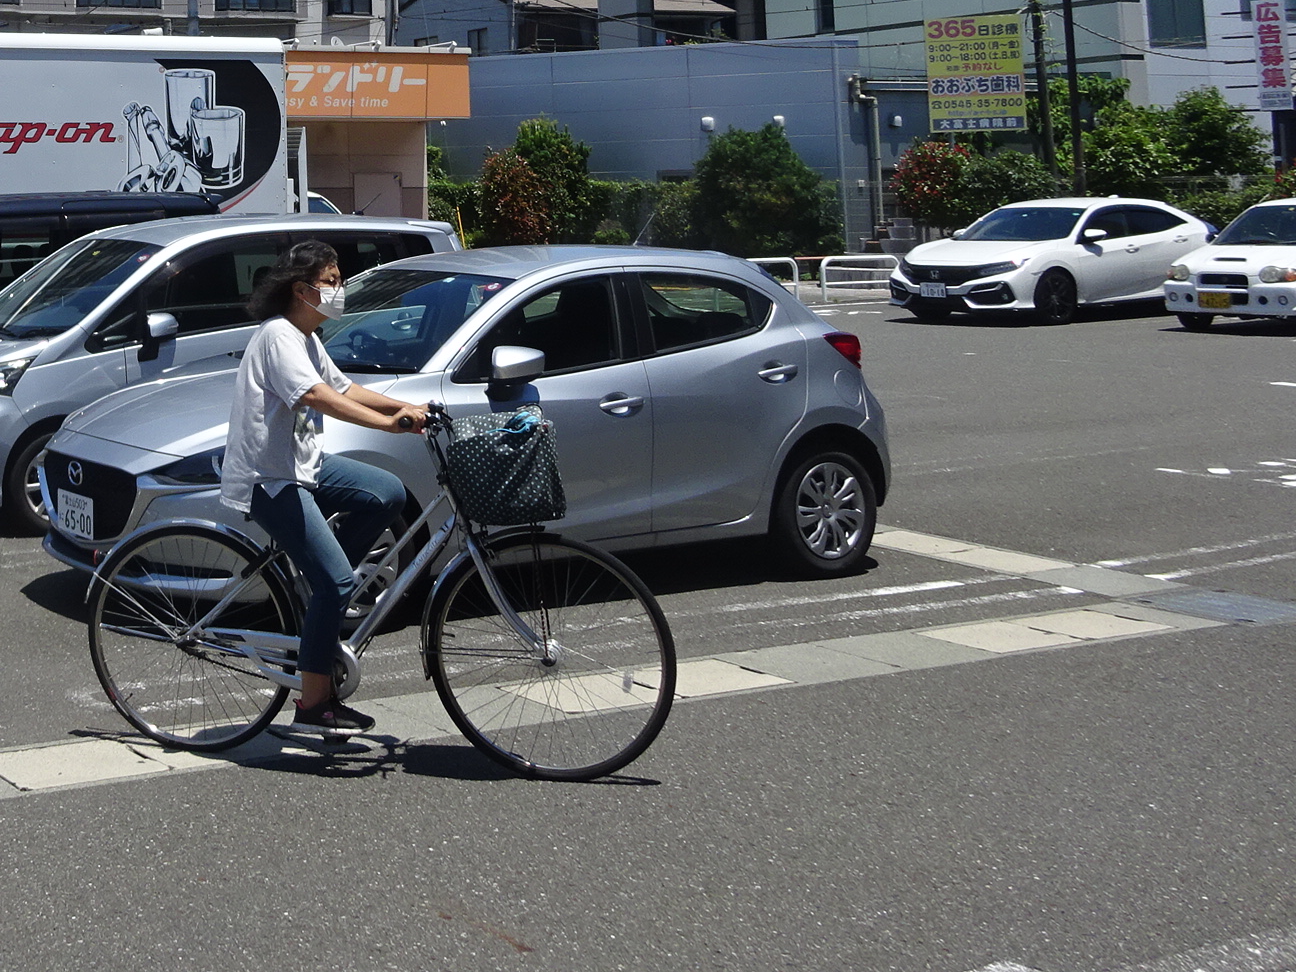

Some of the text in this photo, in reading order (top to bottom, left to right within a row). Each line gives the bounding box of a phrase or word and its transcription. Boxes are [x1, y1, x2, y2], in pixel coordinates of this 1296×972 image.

[927, 19, 1019, 39] 365日診療
[1256, 2, 1286, 88] 広告募集
[287, 64, 427, 93] ランドリー
[931, 75, 1021, 95] おおぶち歯科
[309, 96, 318, 107] &
[323, 97, 355, 107] Save
[360, 96, 389, 107] time
